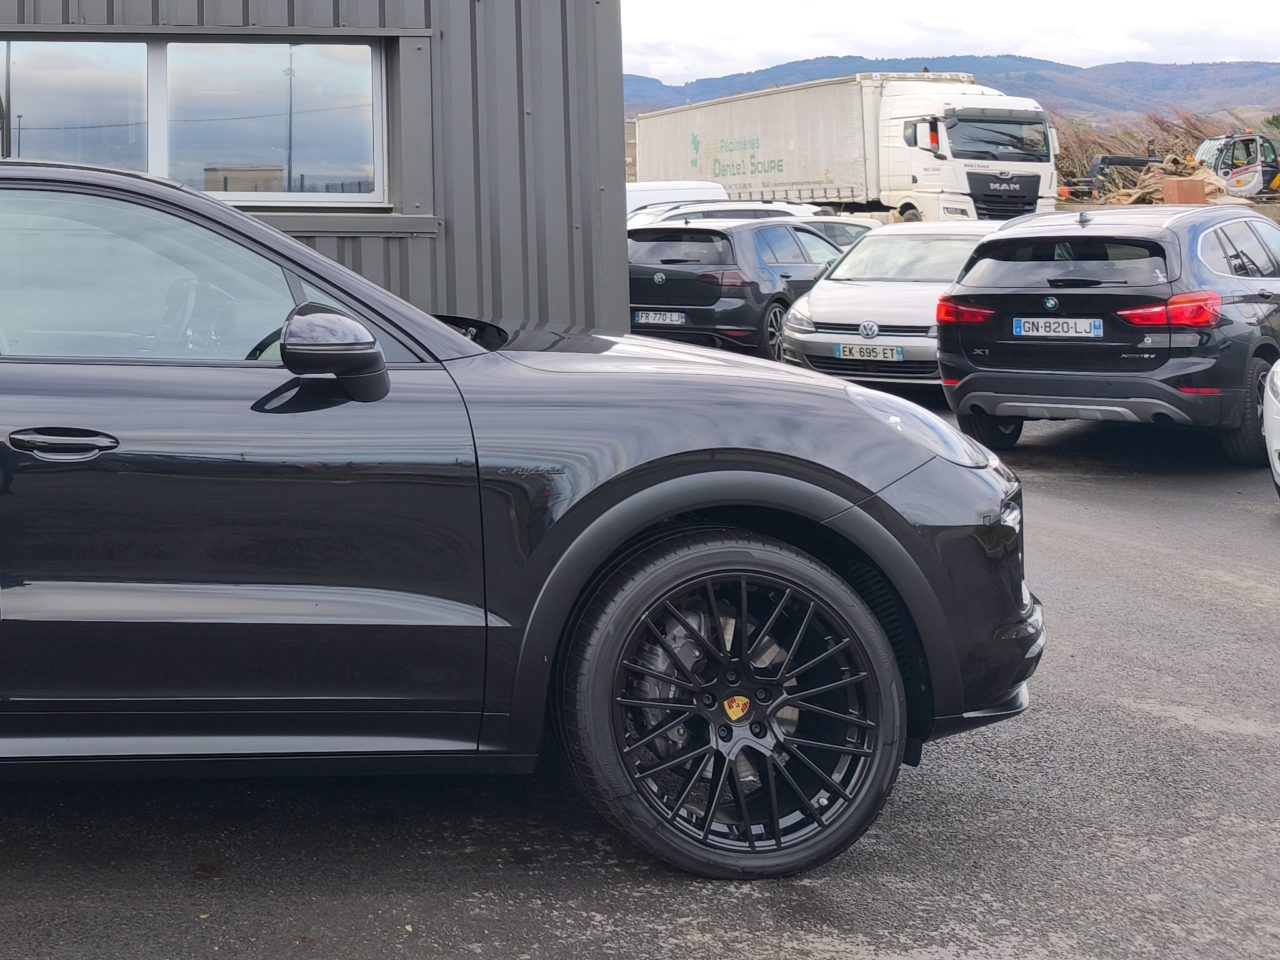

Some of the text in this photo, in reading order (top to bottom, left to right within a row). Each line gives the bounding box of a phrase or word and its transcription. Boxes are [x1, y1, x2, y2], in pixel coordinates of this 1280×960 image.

[989, 183, 1021, 191] MAN
[1022, 320, 1092, 334] GN-820-LJ
[972, 348, 990, 356] X1
